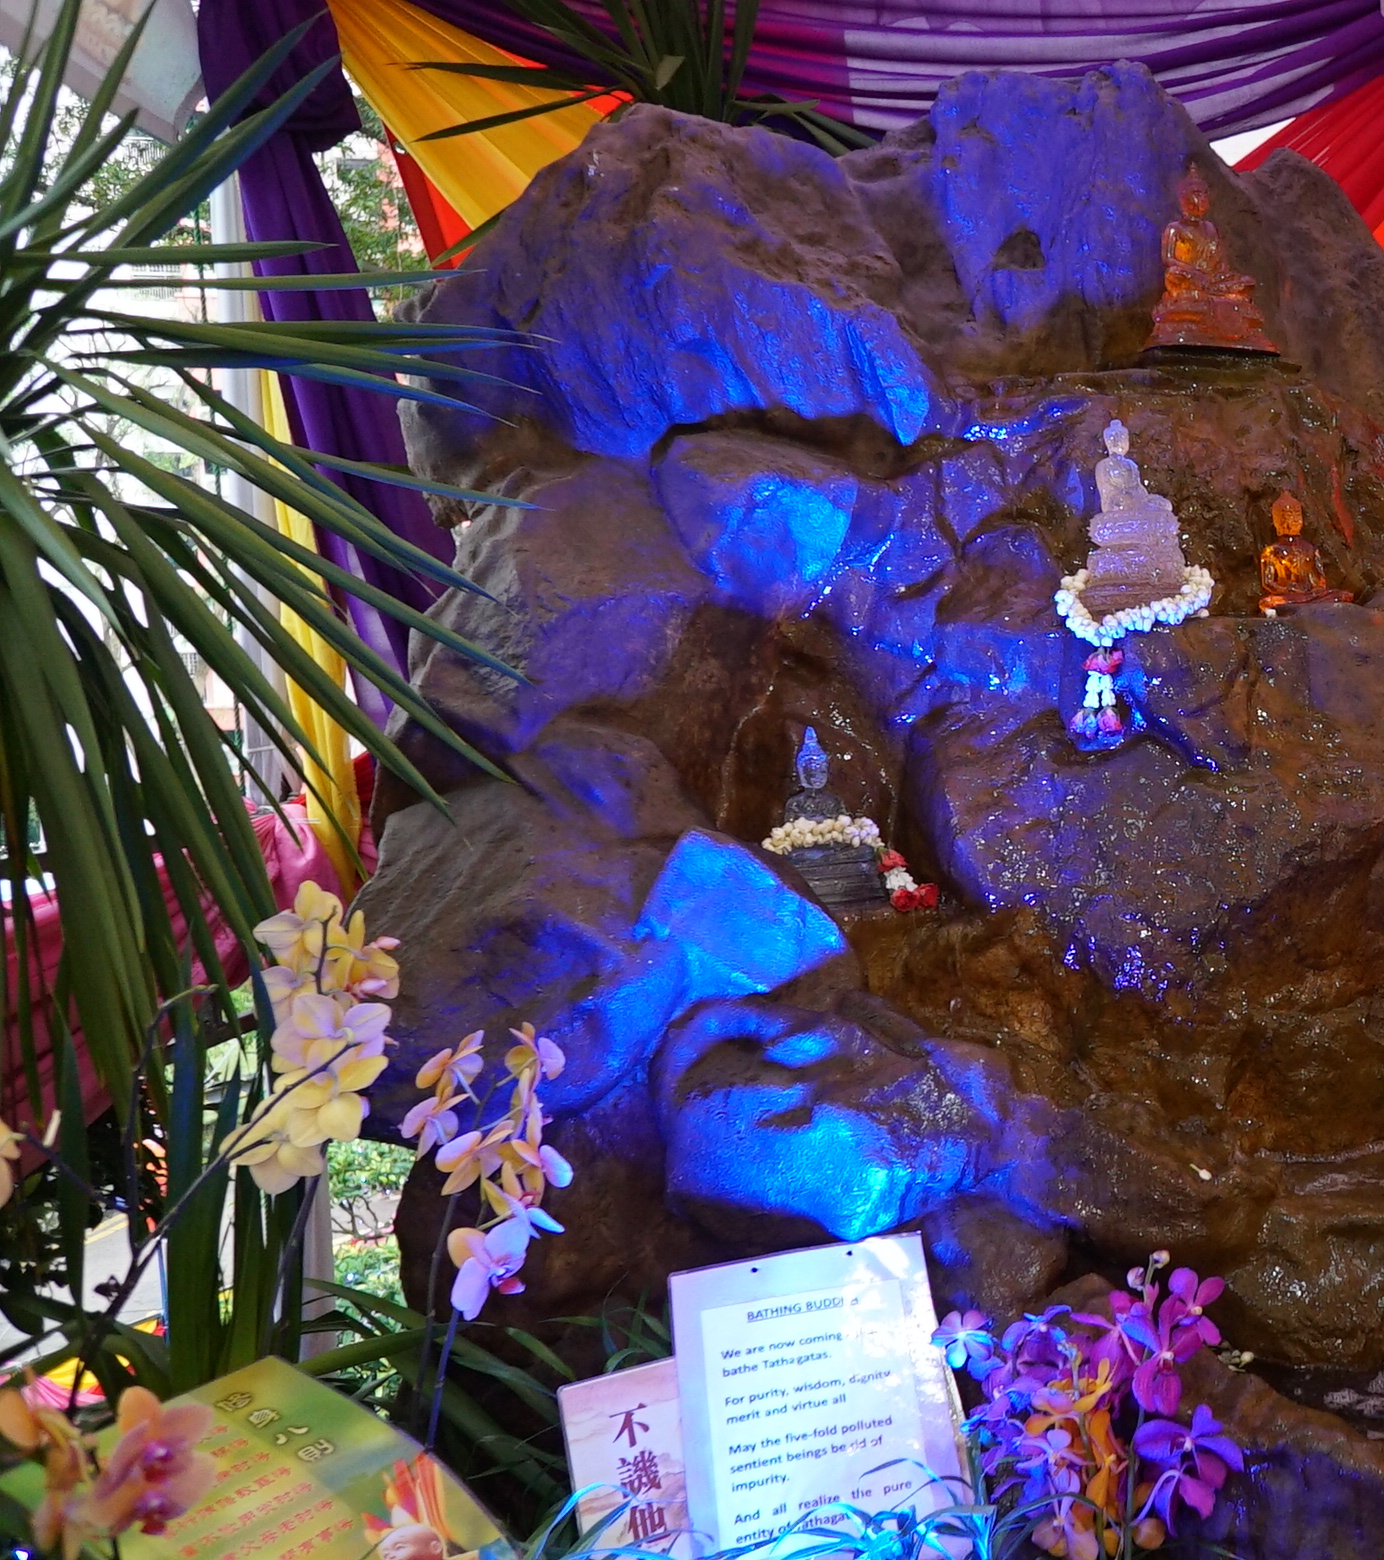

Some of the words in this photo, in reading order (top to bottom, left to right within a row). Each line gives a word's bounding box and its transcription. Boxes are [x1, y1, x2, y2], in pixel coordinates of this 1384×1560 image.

[747, 1302, 802, 1321] BATHING
[721, 1350, 741, 1360] We
[745, 1344, 765, 1355] are
[768, 1340, 796, 1351] now
[799, 1331, 843, 1346] coming
[722, 1363, 758, 1378] bathe
[724, 1396, 745, 1407] For
[748, 1387, 790, 1404] purity,
[793, 1377, 846, 1393] wisdom,
[726, 1410, 760, 1425] merit
[765, 1405, 788, 1417] and
[792, 1398, 829, 1412] virtue
[832, 1394, 847, 1404] all
[729, 1442, 756, 1456] May
[761, 1437, 781, 1448] the
[785, 1425, 838, 1443] five-fold
[841, 1415, 893, 1435] polluted
[730, 1456, 783, 1474] sentient
[786, 1446, 828, 1462] beings
[831, 1443, 847, 1454] be
[850, 1437, 867, 1450] rid
[870, 1434, 884, 1447] of
[731, 1474, 791, 1493] impurity.
[734, 1510, 761, 1525] And
[772, 1503, 788, 1516] all
[798, 1494, 841, 1511] realize
[851, 1486, 873, 1500] the
[883, 1479, 912, 1495] pure
[736, 1525, 774, 1545] entity
